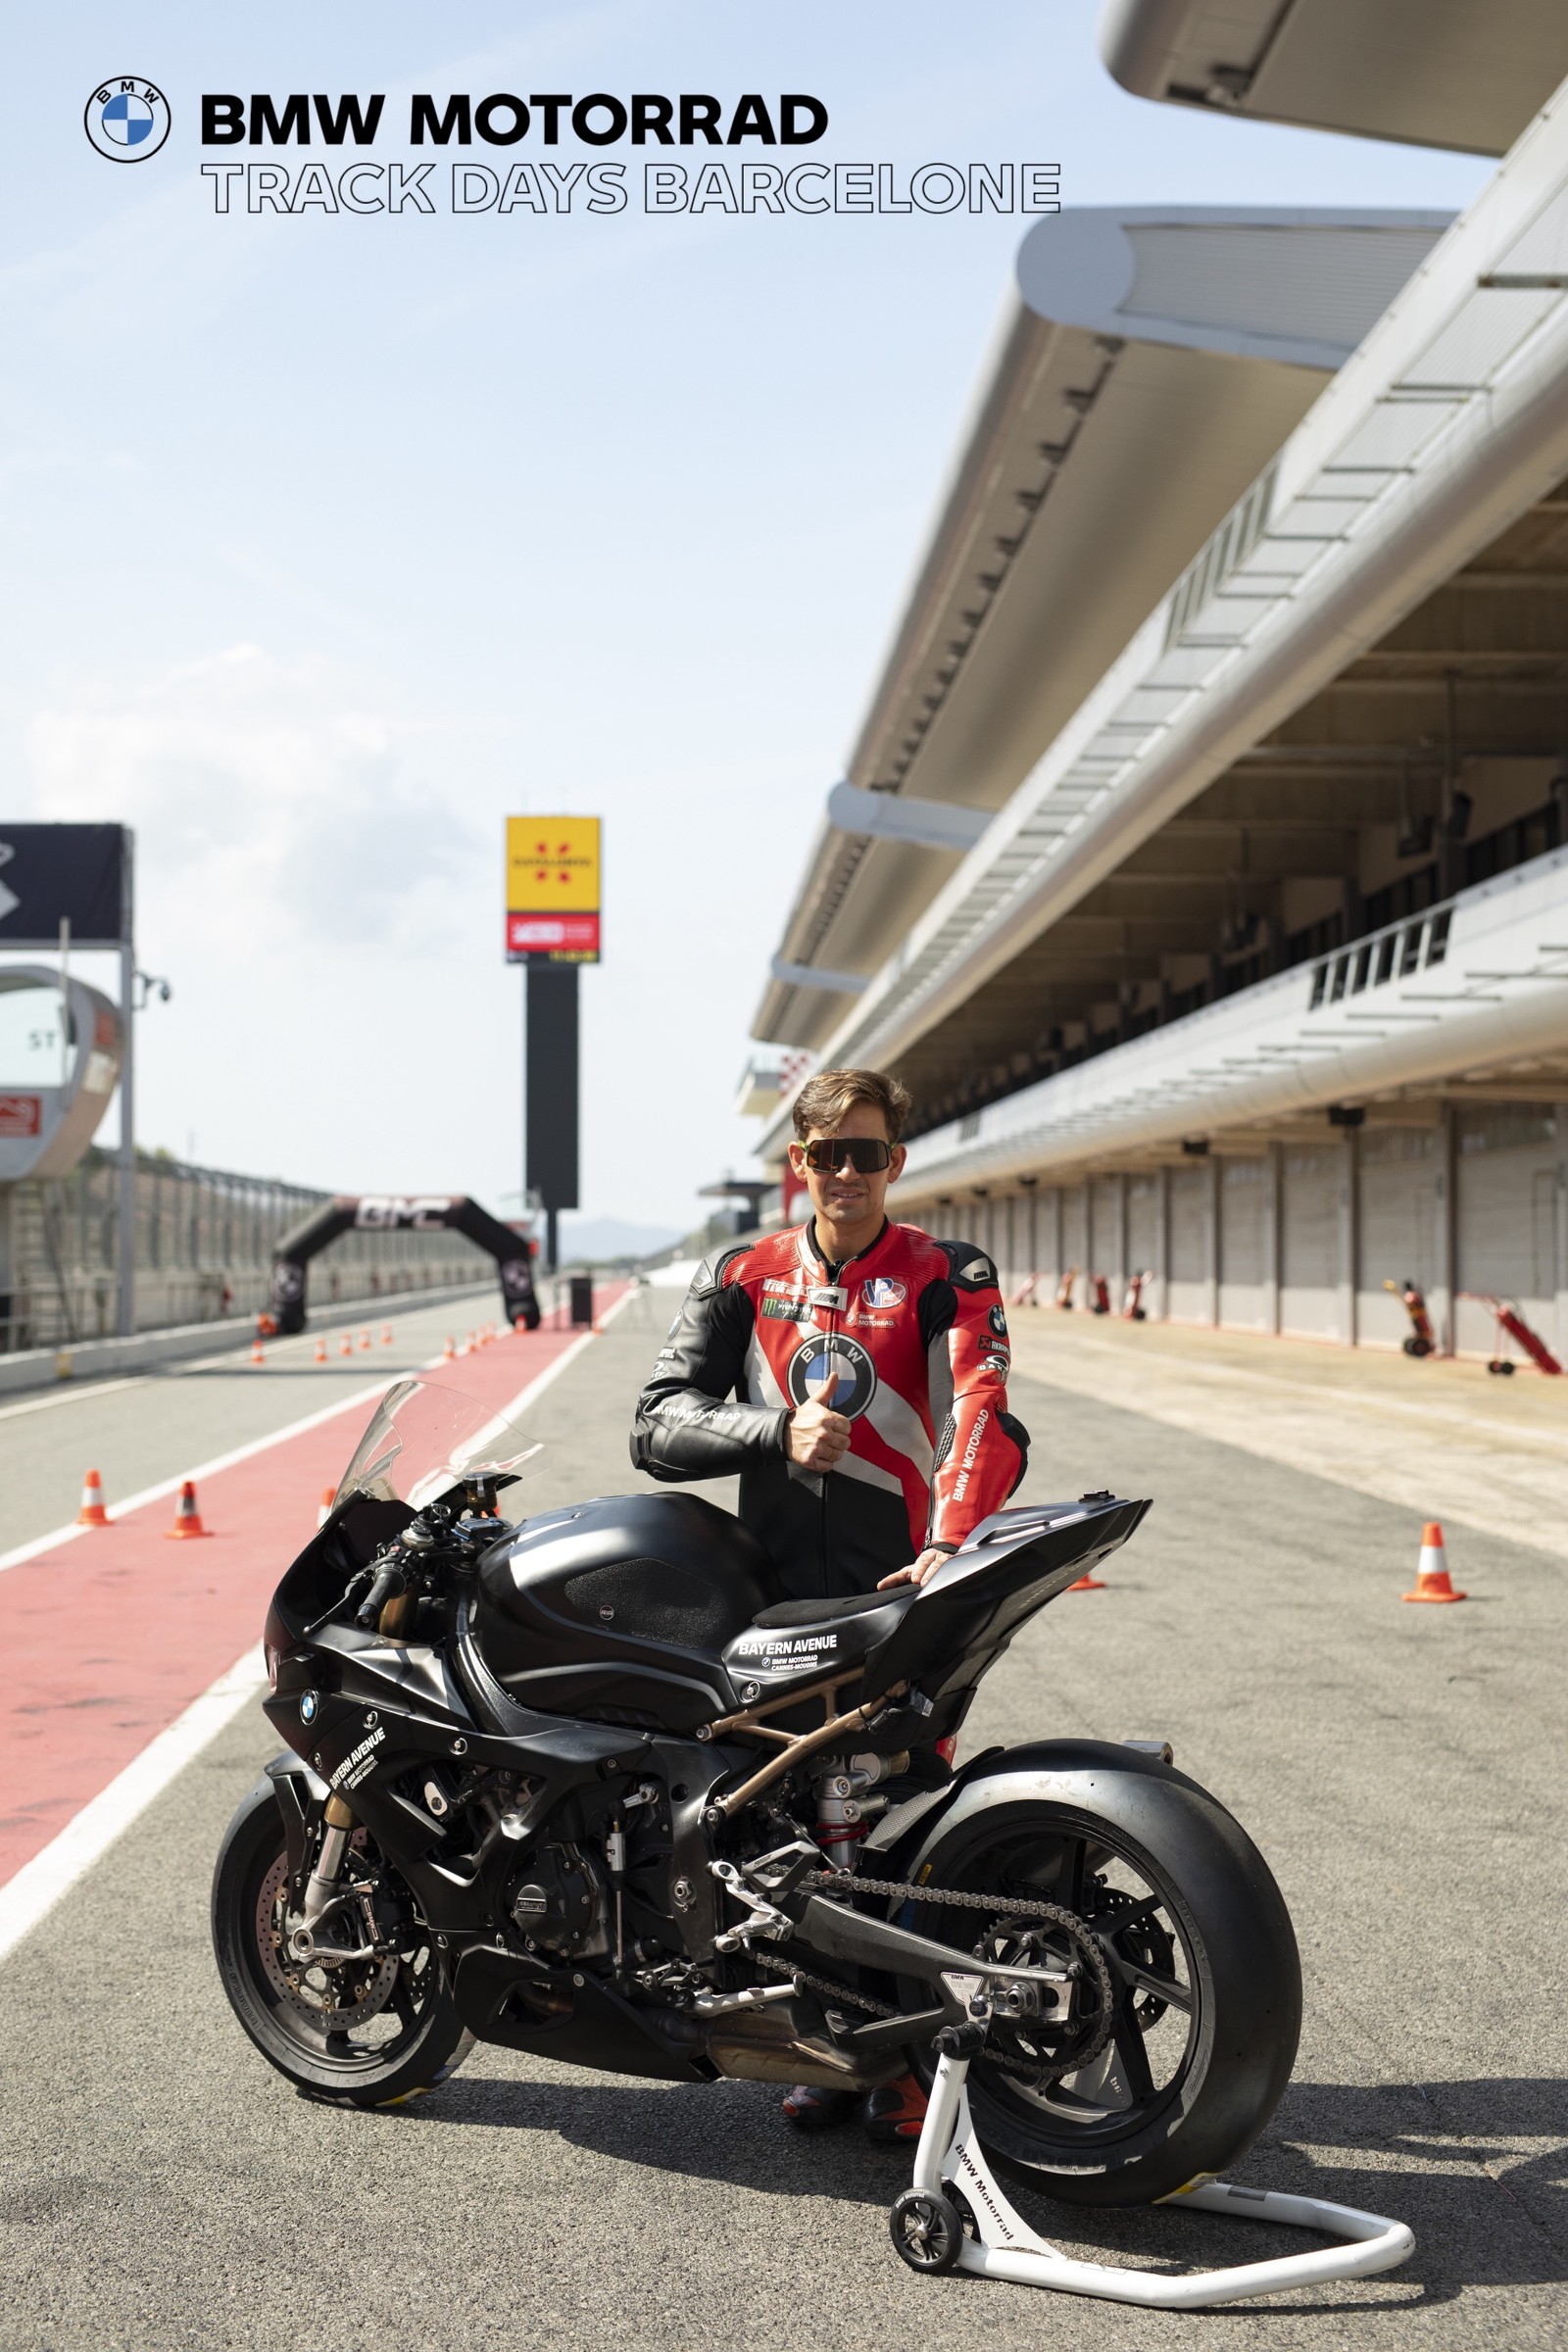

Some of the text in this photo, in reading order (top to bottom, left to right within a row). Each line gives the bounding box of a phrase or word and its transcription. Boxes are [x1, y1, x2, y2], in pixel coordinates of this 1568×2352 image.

[800, 1338, 863, 1364] BMW
[953, 1408, 989, 1502] BMW MOTORRAD
[738, 1634, 838, 1656] BAYERN AVENUE
[788, 1654, 818, 1665] MOTORRAD
[329, 1727, 386, 1790] BAYERN AVENUE
[955, 2143, 1014, 2241] BMW Motorrad
